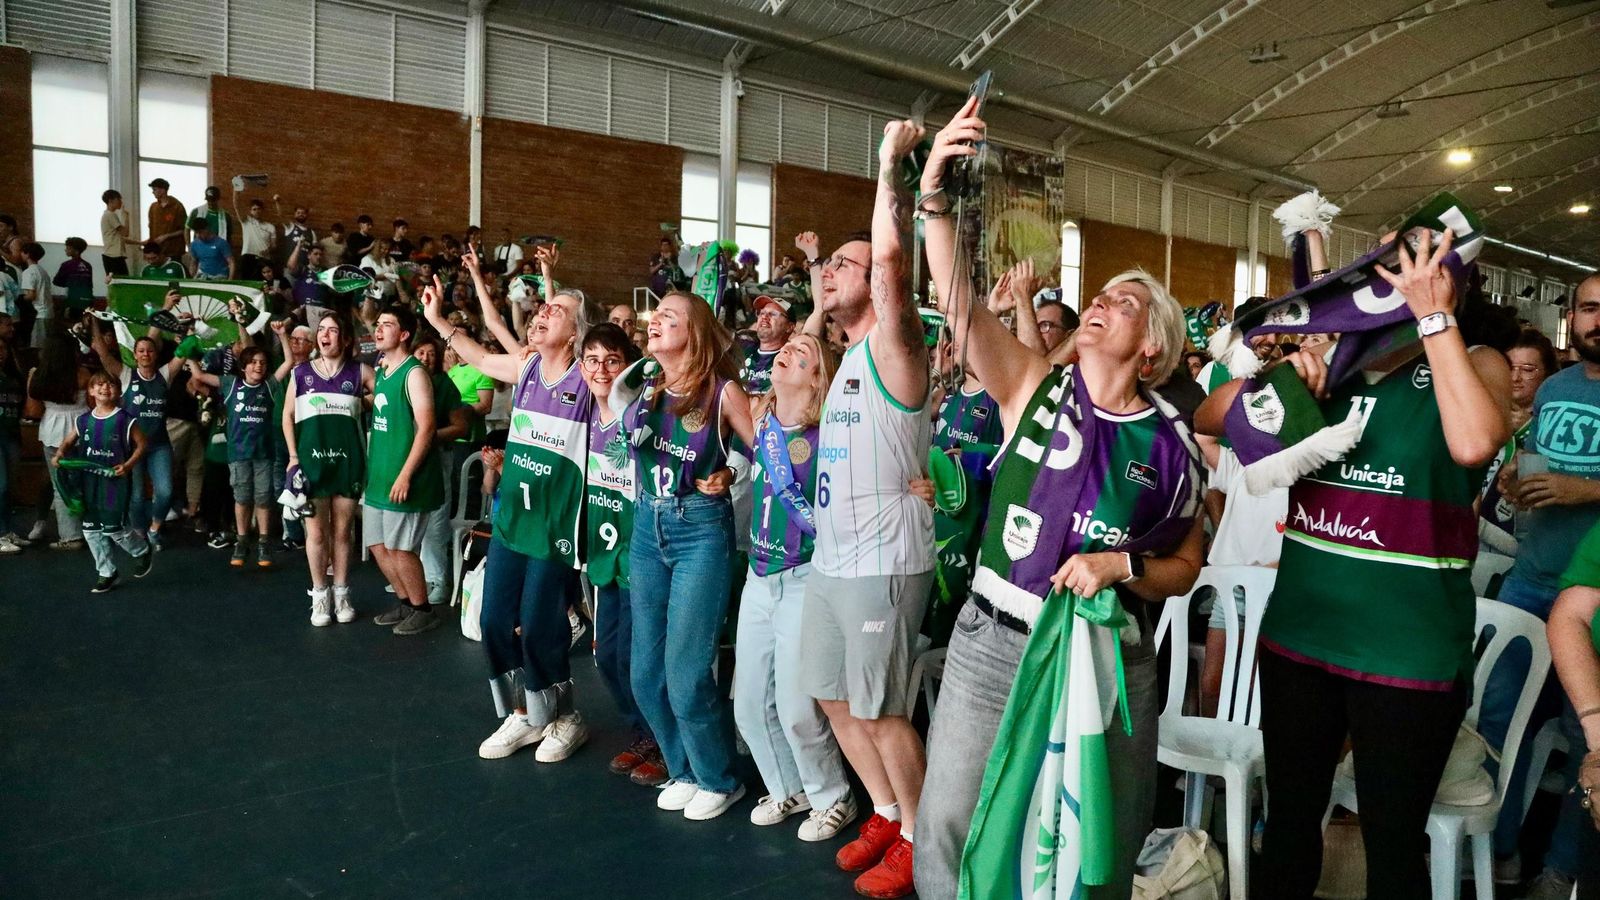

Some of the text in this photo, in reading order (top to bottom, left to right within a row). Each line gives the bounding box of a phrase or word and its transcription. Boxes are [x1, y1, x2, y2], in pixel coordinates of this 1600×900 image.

[531, 430, 566, 447] Unicaja
[653, 435, 697, 462] Unicaja
[947, 426, 979, 444] Unicaja
[512, 452, 552, 476] málaga
[1340, 463, 1405, 489] Unicaja
[601, 471, 632, 487] Unicaja
[650, 464, 675, 497] 12
[520, 481, 531, 510] 1
[763, 495, 772, 529] 1
[1293, 502, 1385, 547] Andalucía
[599, 522, 618, 550] 9
[1072, 509, 1131, 547] nicaj
[861, 620, 886, 633] NIKE
